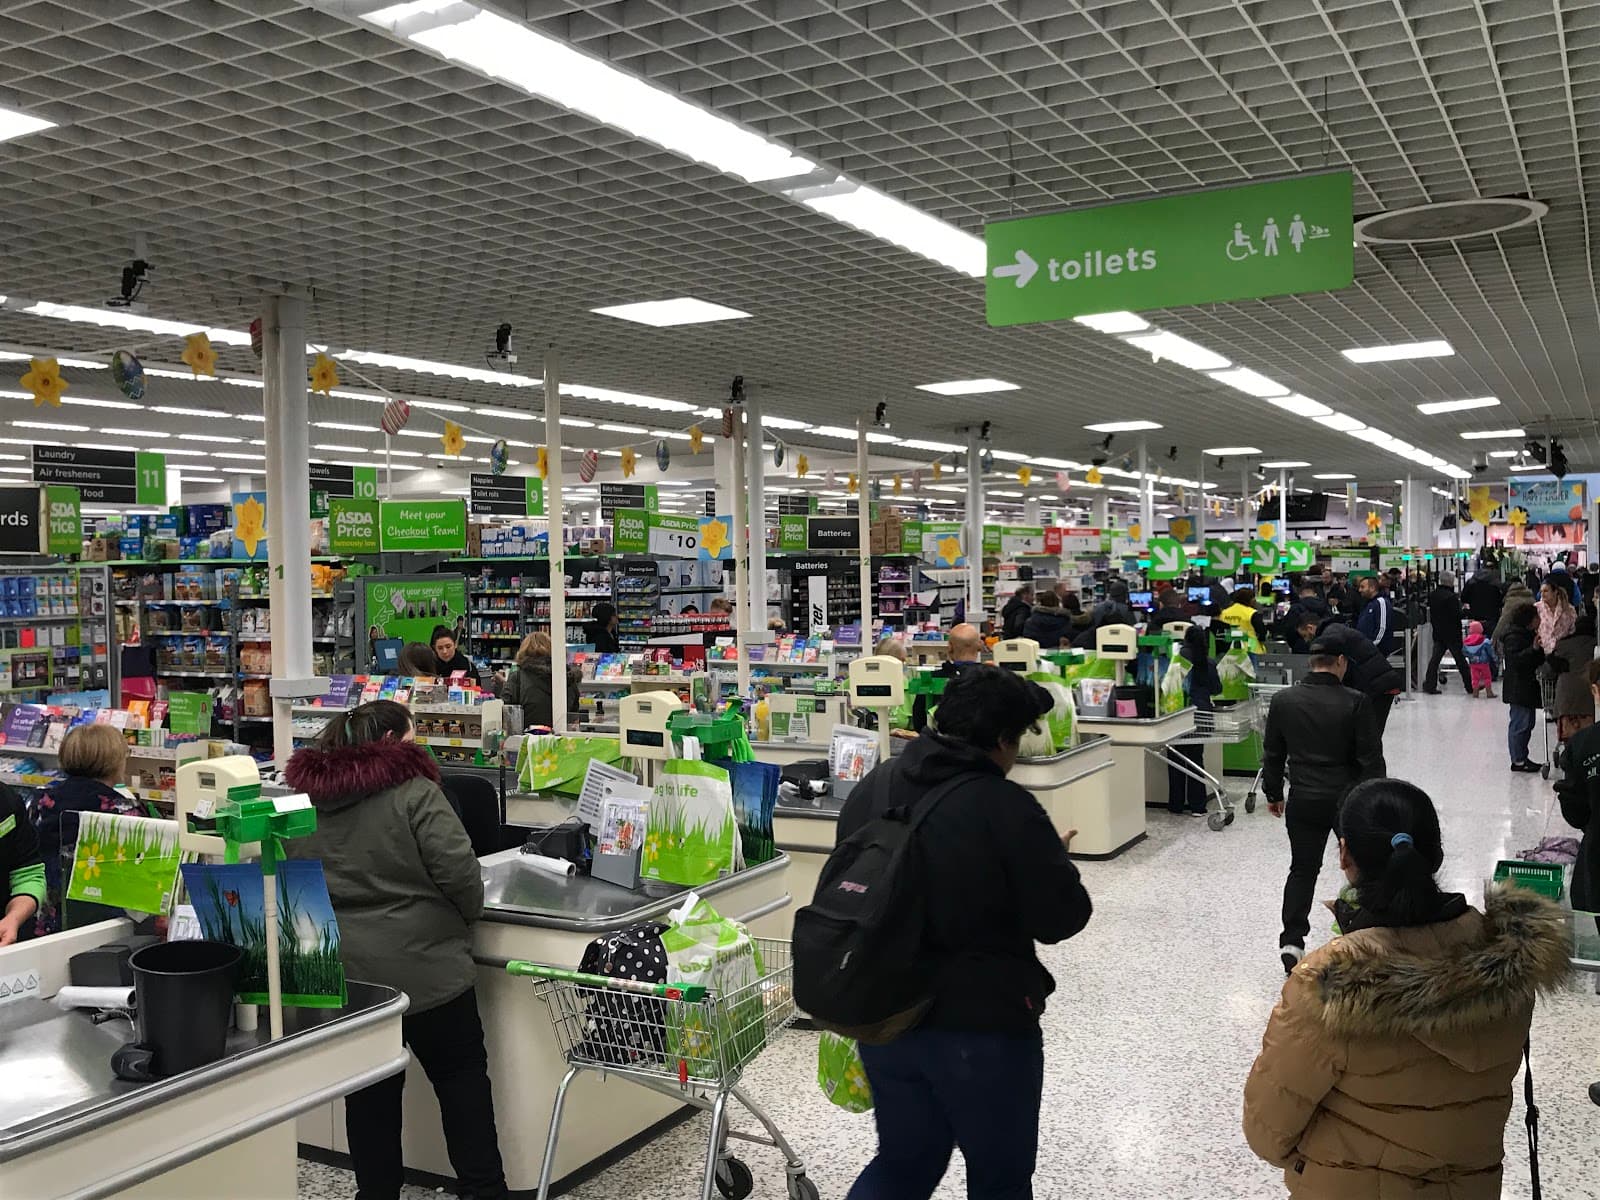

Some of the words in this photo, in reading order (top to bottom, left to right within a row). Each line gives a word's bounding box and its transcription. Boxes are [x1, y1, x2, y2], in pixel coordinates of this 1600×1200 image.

[1047, 247, 1157, 283] toilets
[38, 450, 76, 461] Laundry
[39, 468, 53, 477] Air
[55, 469, 101, 479] fresheners
[142, 470, 160, 488] 11
[473, 475, 494, 485] Nappies
[83, 489, 104, 498] food
[357, 481, 375, 497] 10
[530, 490, 539, 503] 9
[648, 496, 654, 508] 8
[50, 502, 77, 518] SDA
[400, 510, 422, 520] Meet
[425, 512, 446, 522] your
[0, 511, 29, 526] rds
[336, 511, 373, 524] ASDA
[618, 518, 644, 529] ASDA
[660, 519, 681, 528] ASDA
[50, 517, 76, 533] rice
[337, 525, 372, 537] Price
[784, 523, 803, 532] ASDA
[387, 525, 429, 538] Checkout
[432, 525, 459, 536] Team!
[619, 528, 643, 539] Price
[785, 532, 803, 541] Price
[795, 562, 829, 570] Batteries
[813, 602, 823, 626] zer
[654, 784, 664, 797] ag
[677, 783, 698, 797] life
[678, 956, 713, 973] bag
